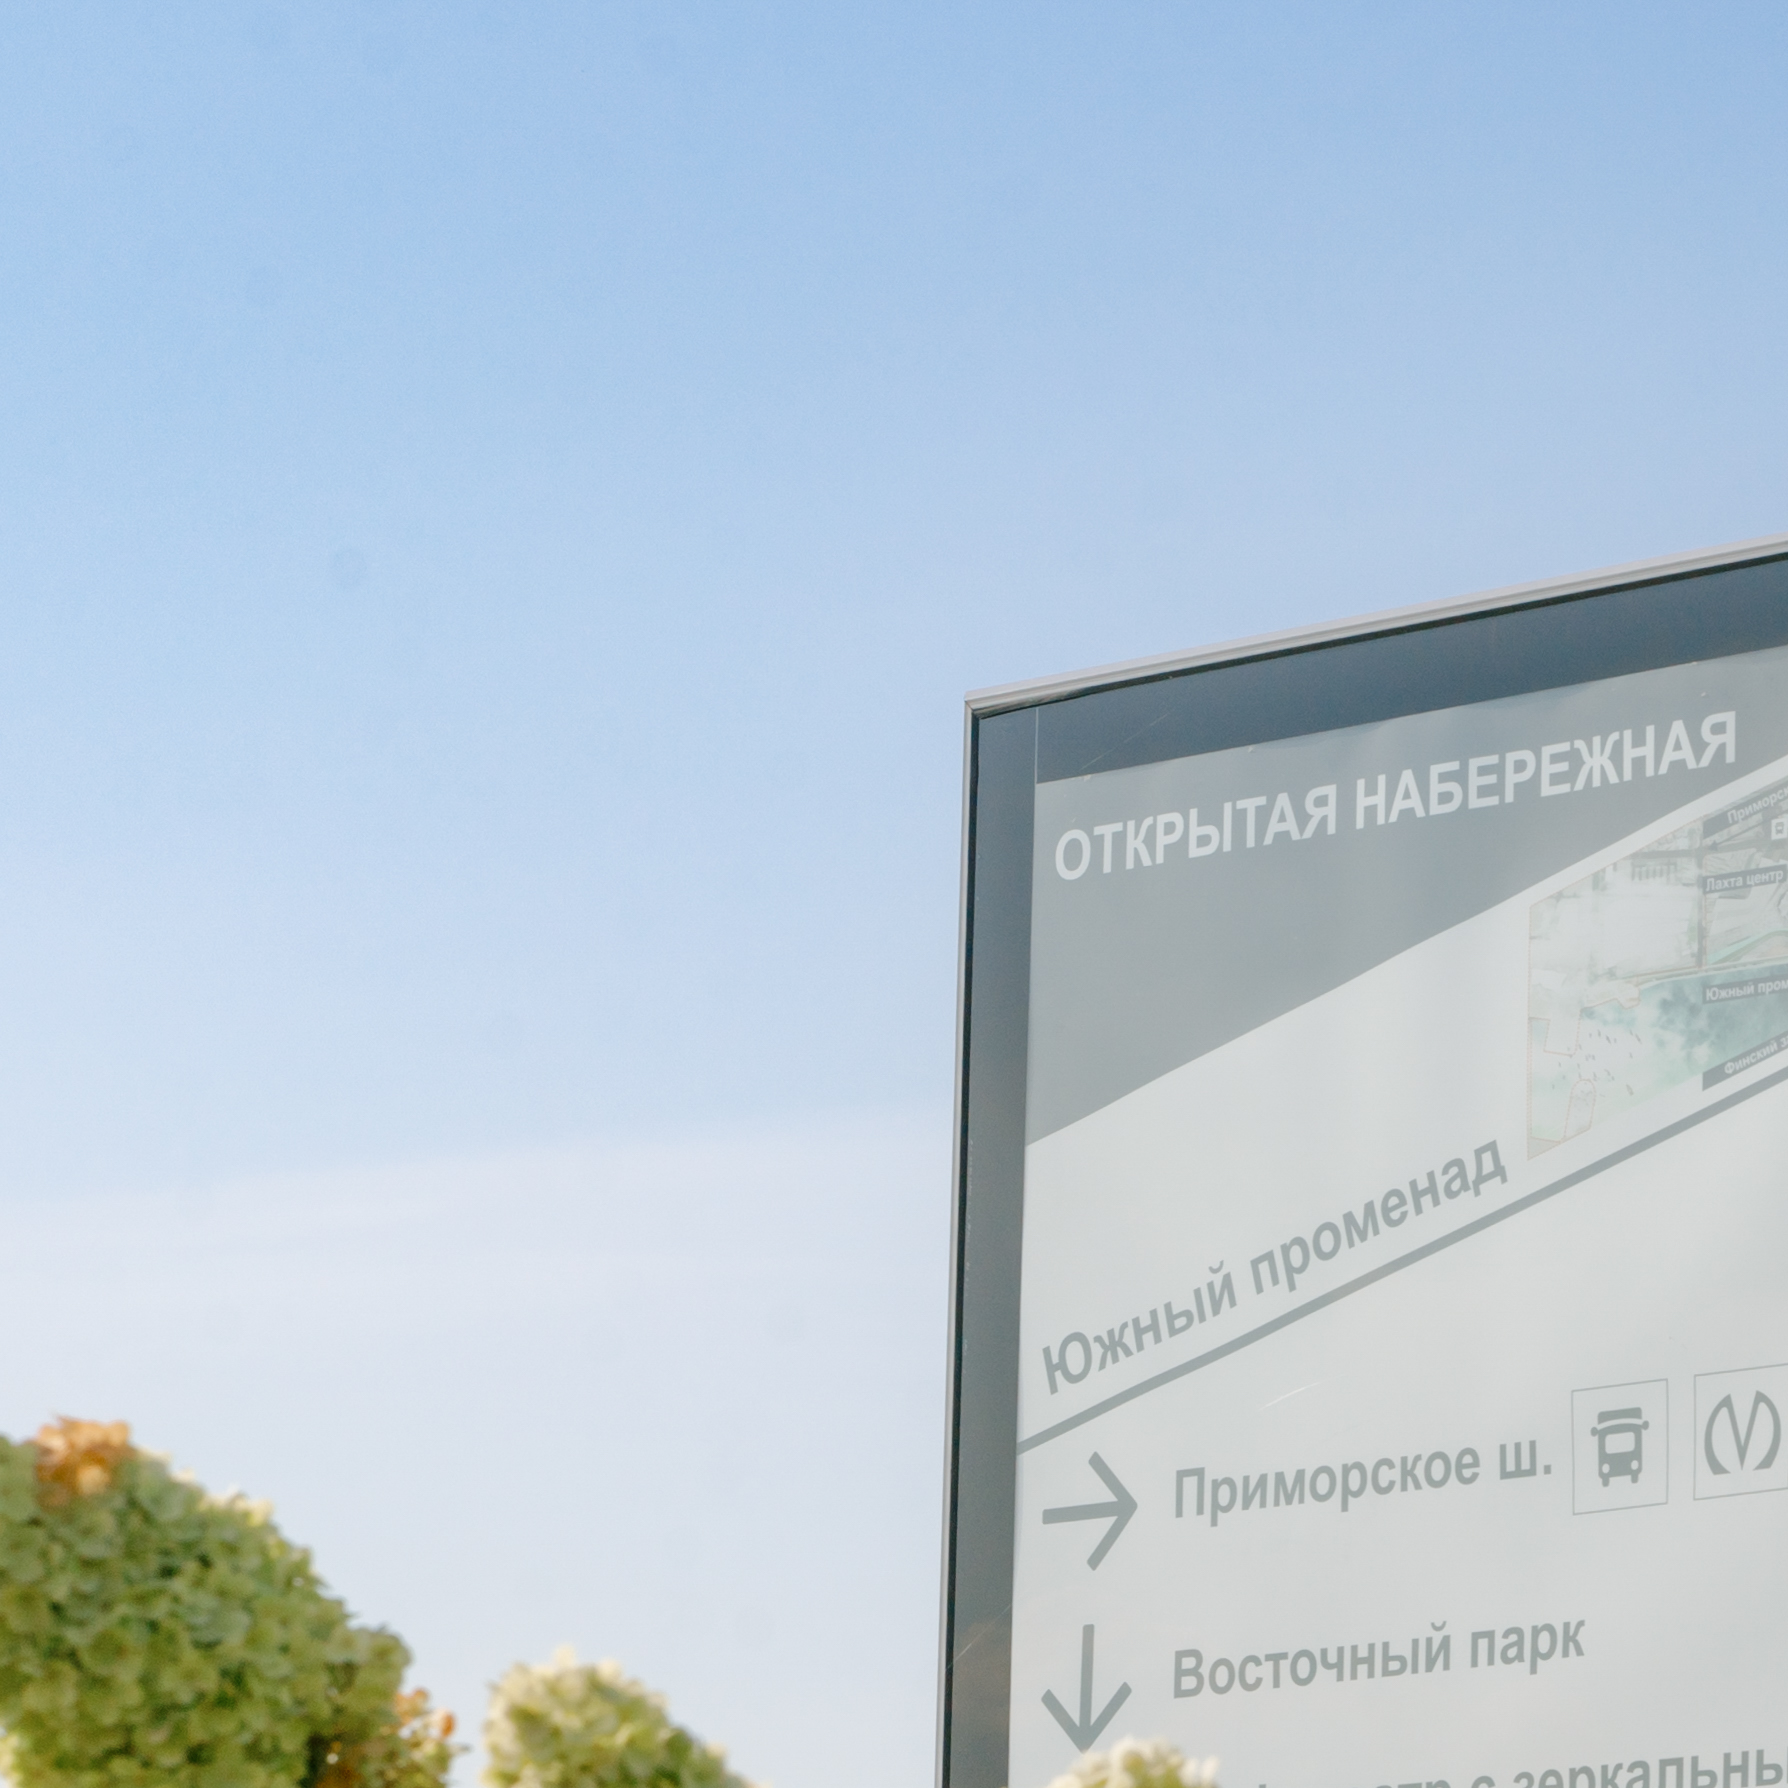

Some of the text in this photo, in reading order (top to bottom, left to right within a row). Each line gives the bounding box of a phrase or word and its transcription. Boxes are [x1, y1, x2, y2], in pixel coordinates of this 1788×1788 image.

[1054, 711, 1737, 881] ОТКРЫТАЯ НАБЕРЕЖНАЯ
[1705, 869, 1784, 892] Лахта центр
[1705, 982, 1755, 1001] Южный
[1724, 1041, 1778, 1074] Финский
[1042, 1139, 1508, 1394] Южный променад
[1175, 1439, 1553, 1526] Приморское ш.
[1173, 1620, 1585, 1699] Восточный парк
